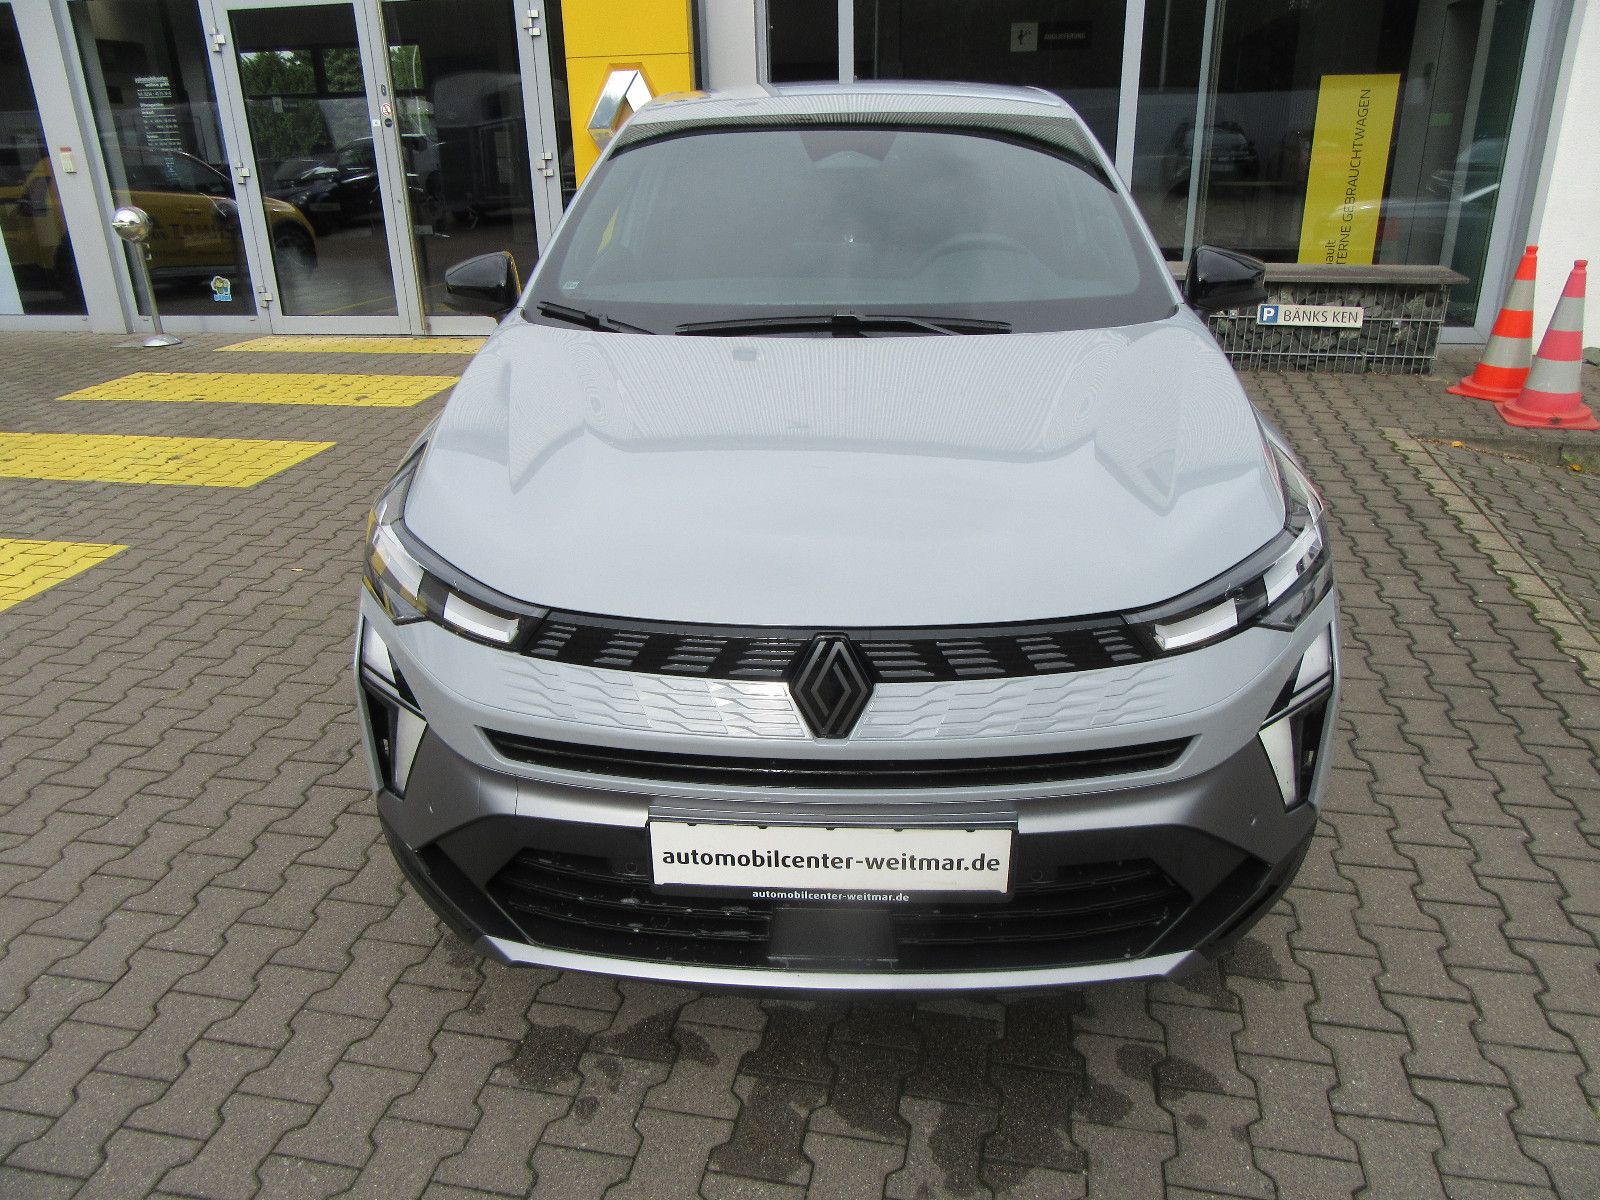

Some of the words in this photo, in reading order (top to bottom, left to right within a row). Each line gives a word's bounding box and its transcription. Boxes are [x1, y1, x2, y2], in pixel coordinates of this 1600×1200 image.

[1342, 88, 1372, 222] GEBRAUCHTWAGEN
[1262, 307, 1275, 321] P
[1283, 307, 1328, 323] BÄNKS
[1332, 311, 1358, 324] KEN
[662, 848, 1001, 872] automobilcenter-weitmar.de
[752, 889, 910, 902] automobilcenter-weitmar.de
